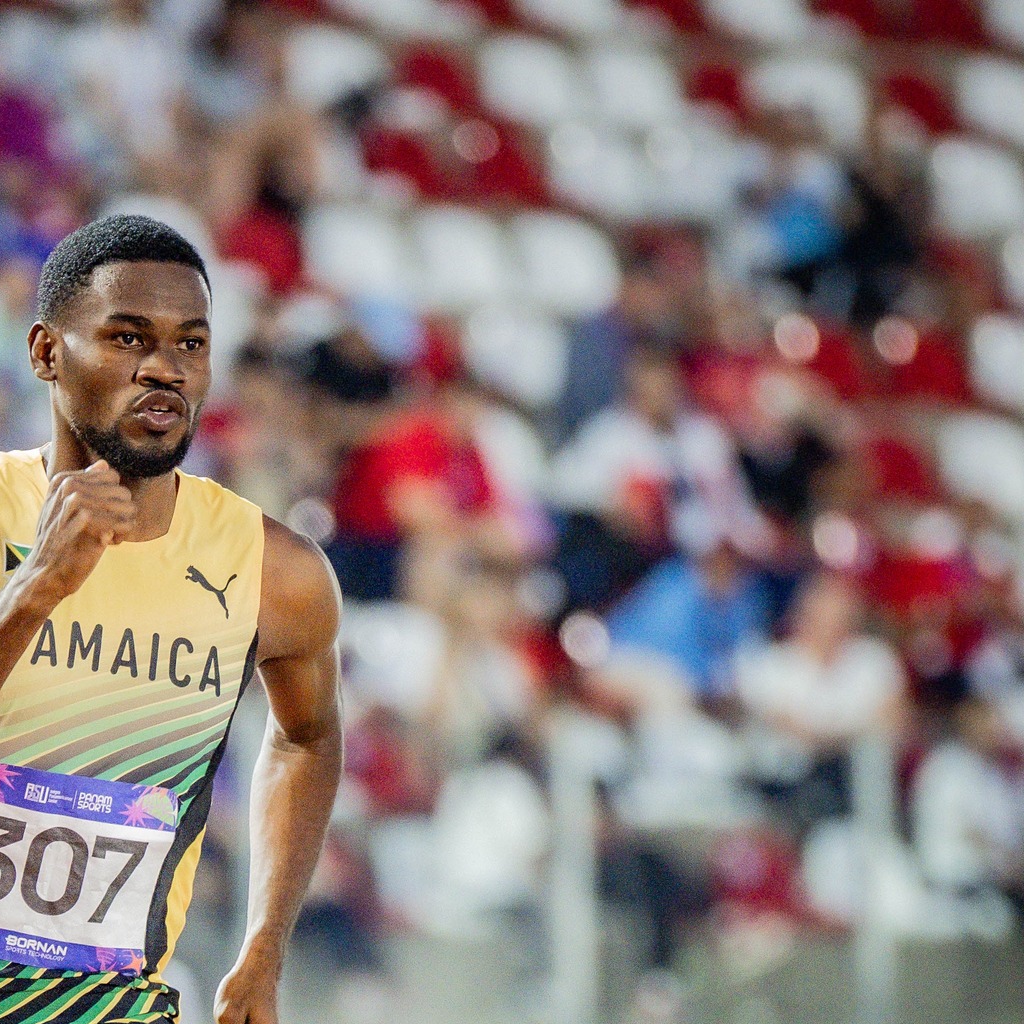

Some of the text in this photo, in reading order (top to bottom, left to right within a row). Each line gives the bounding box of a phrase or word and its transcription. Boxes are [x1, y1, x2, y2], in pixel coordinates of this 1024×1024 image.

[30, 619, 221, 697] AMAICA
[77, 800, 112, 814] SPORTS
[78, 792, 113, 807] PANAM
[5, 934, 68, 956] BORNAN
[5, 945, 65, 962] SPORTS TECHNOLOGY
